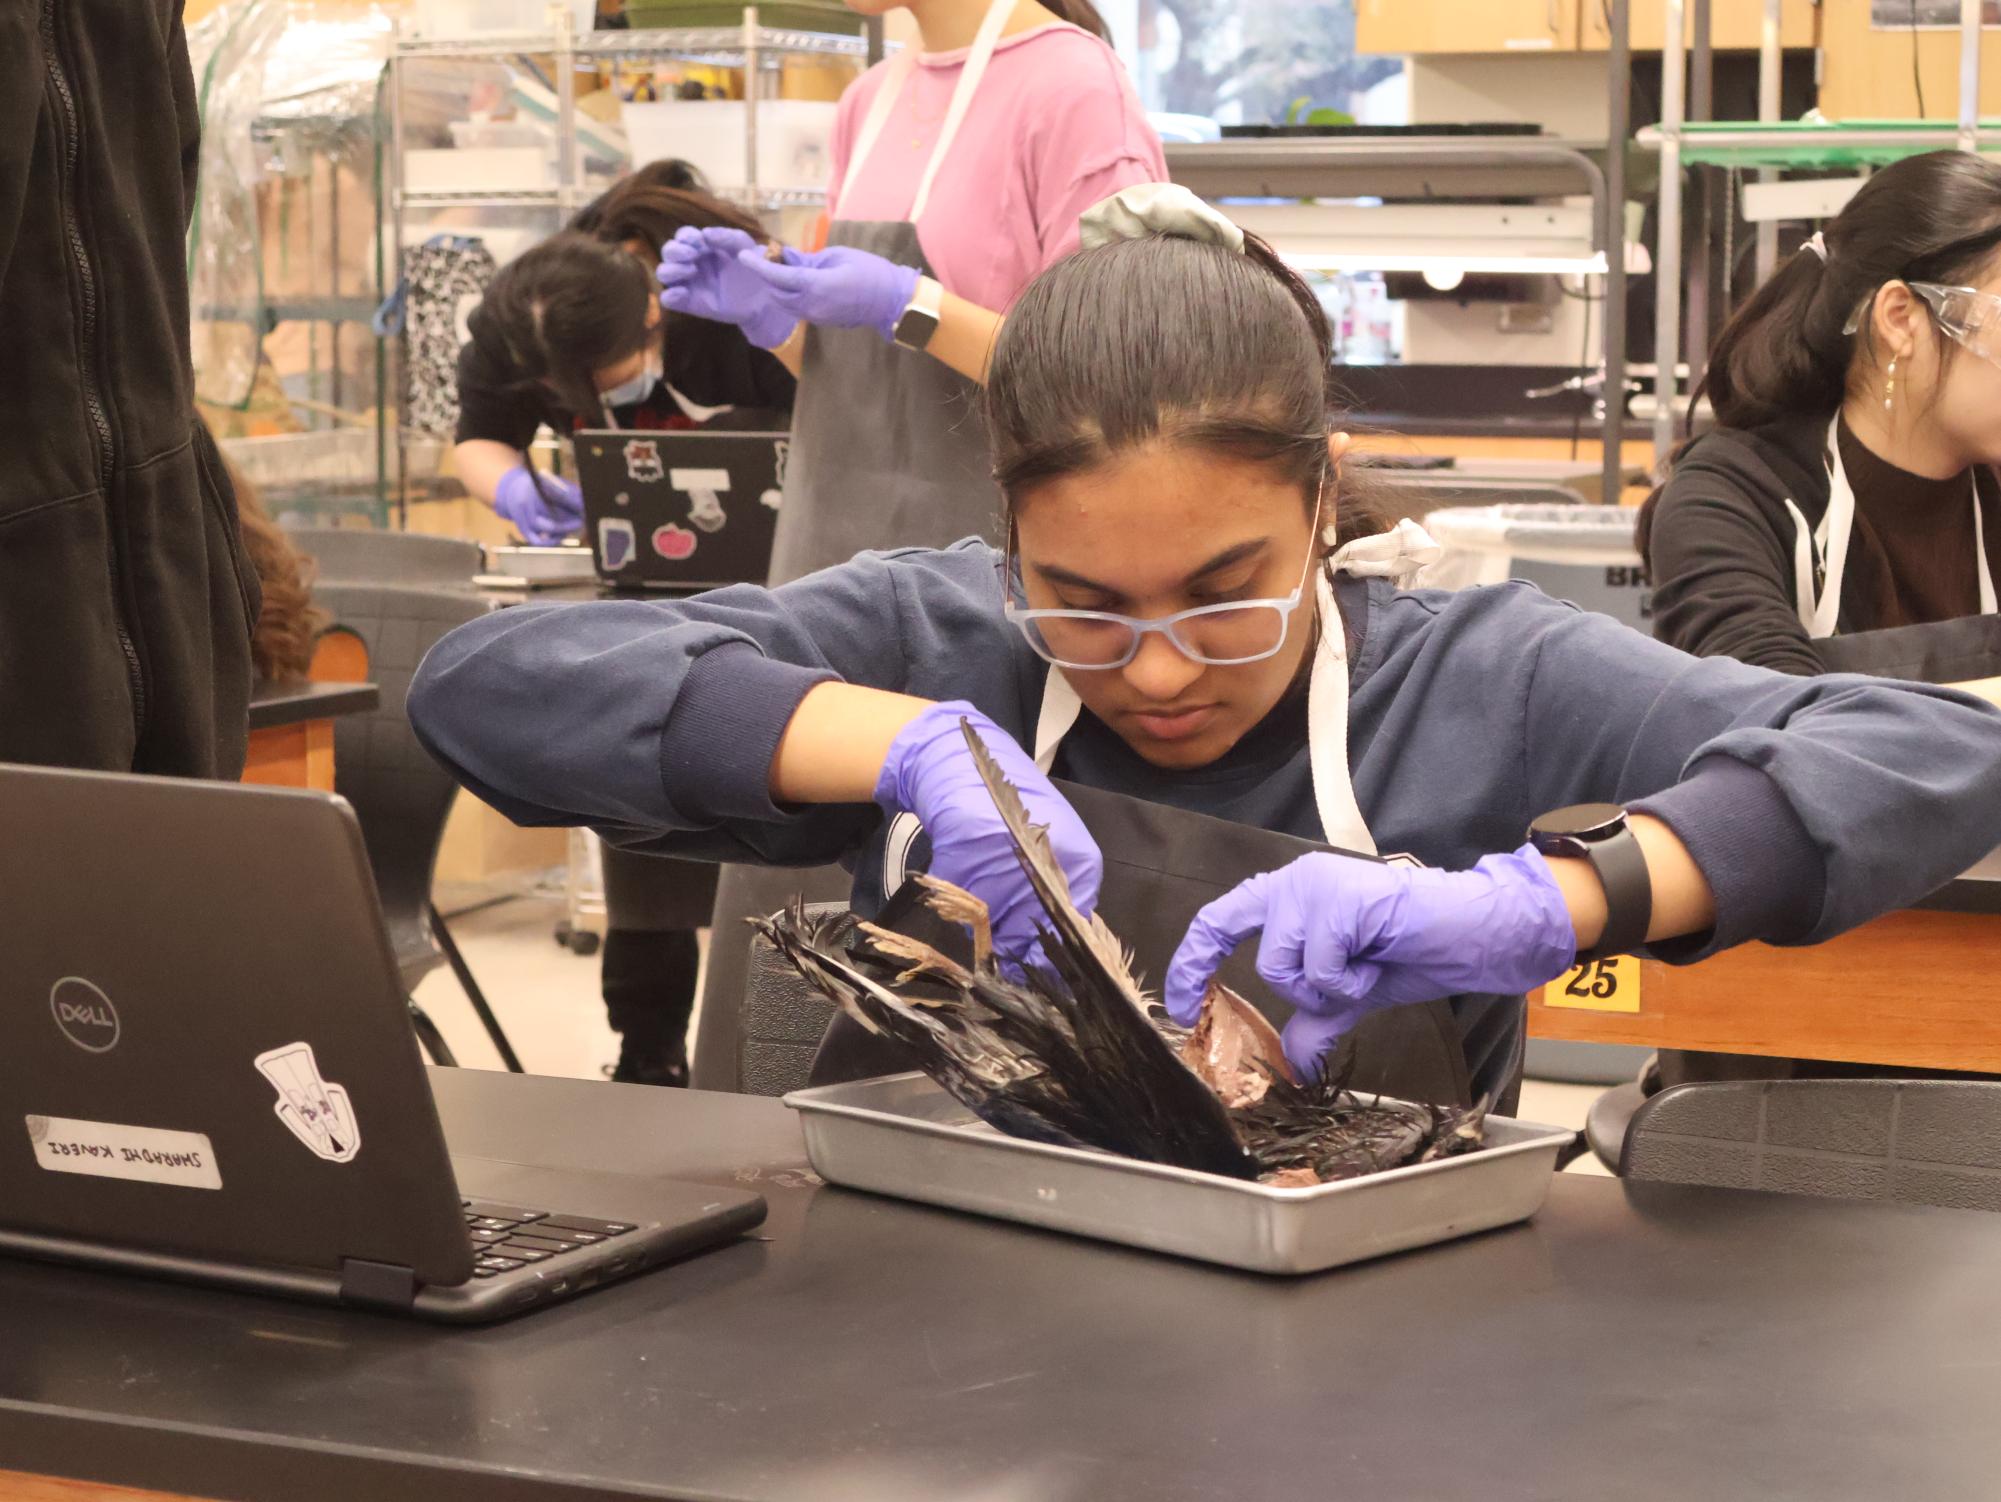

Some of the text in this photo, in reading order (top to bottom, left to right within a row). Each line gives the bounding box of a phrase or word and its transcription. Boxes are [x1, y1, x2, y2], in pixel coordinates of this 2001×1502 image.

[1564, 958, 1619, 999] 25
[58, 1002, 114, 1028] DELL
[47, 1141, 114, 1159] KAVERI
